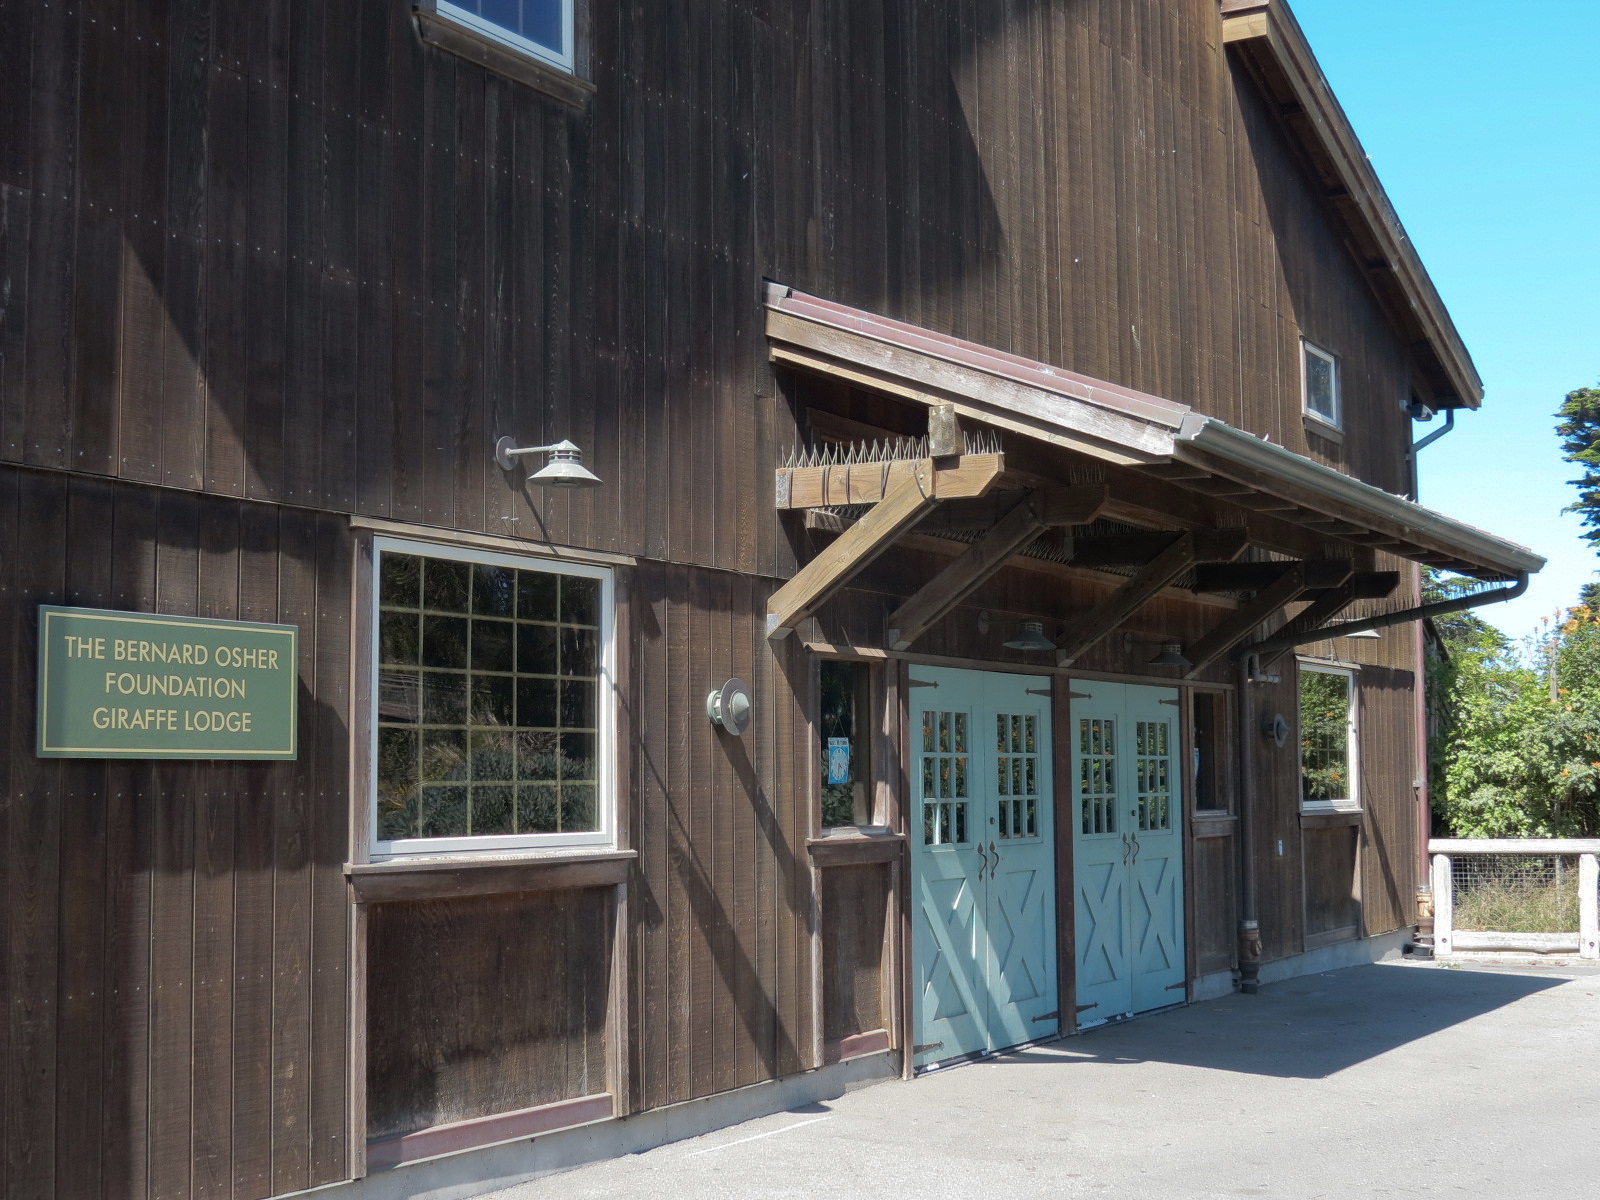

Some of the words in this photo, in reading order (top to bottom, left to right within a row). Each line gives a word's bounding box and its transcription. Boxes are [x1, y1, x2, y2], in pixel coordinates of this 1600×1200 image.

[64, 635, 105, 660] THE
[114, 639, 209, 666] BERNARD
[215, 646, 279, 670] OSHER
[105, 672, 246, 699] FOUNDATION
[92, 707, 178, 731] GIRAFFE
[185, 710, 252, 733] LODGE
